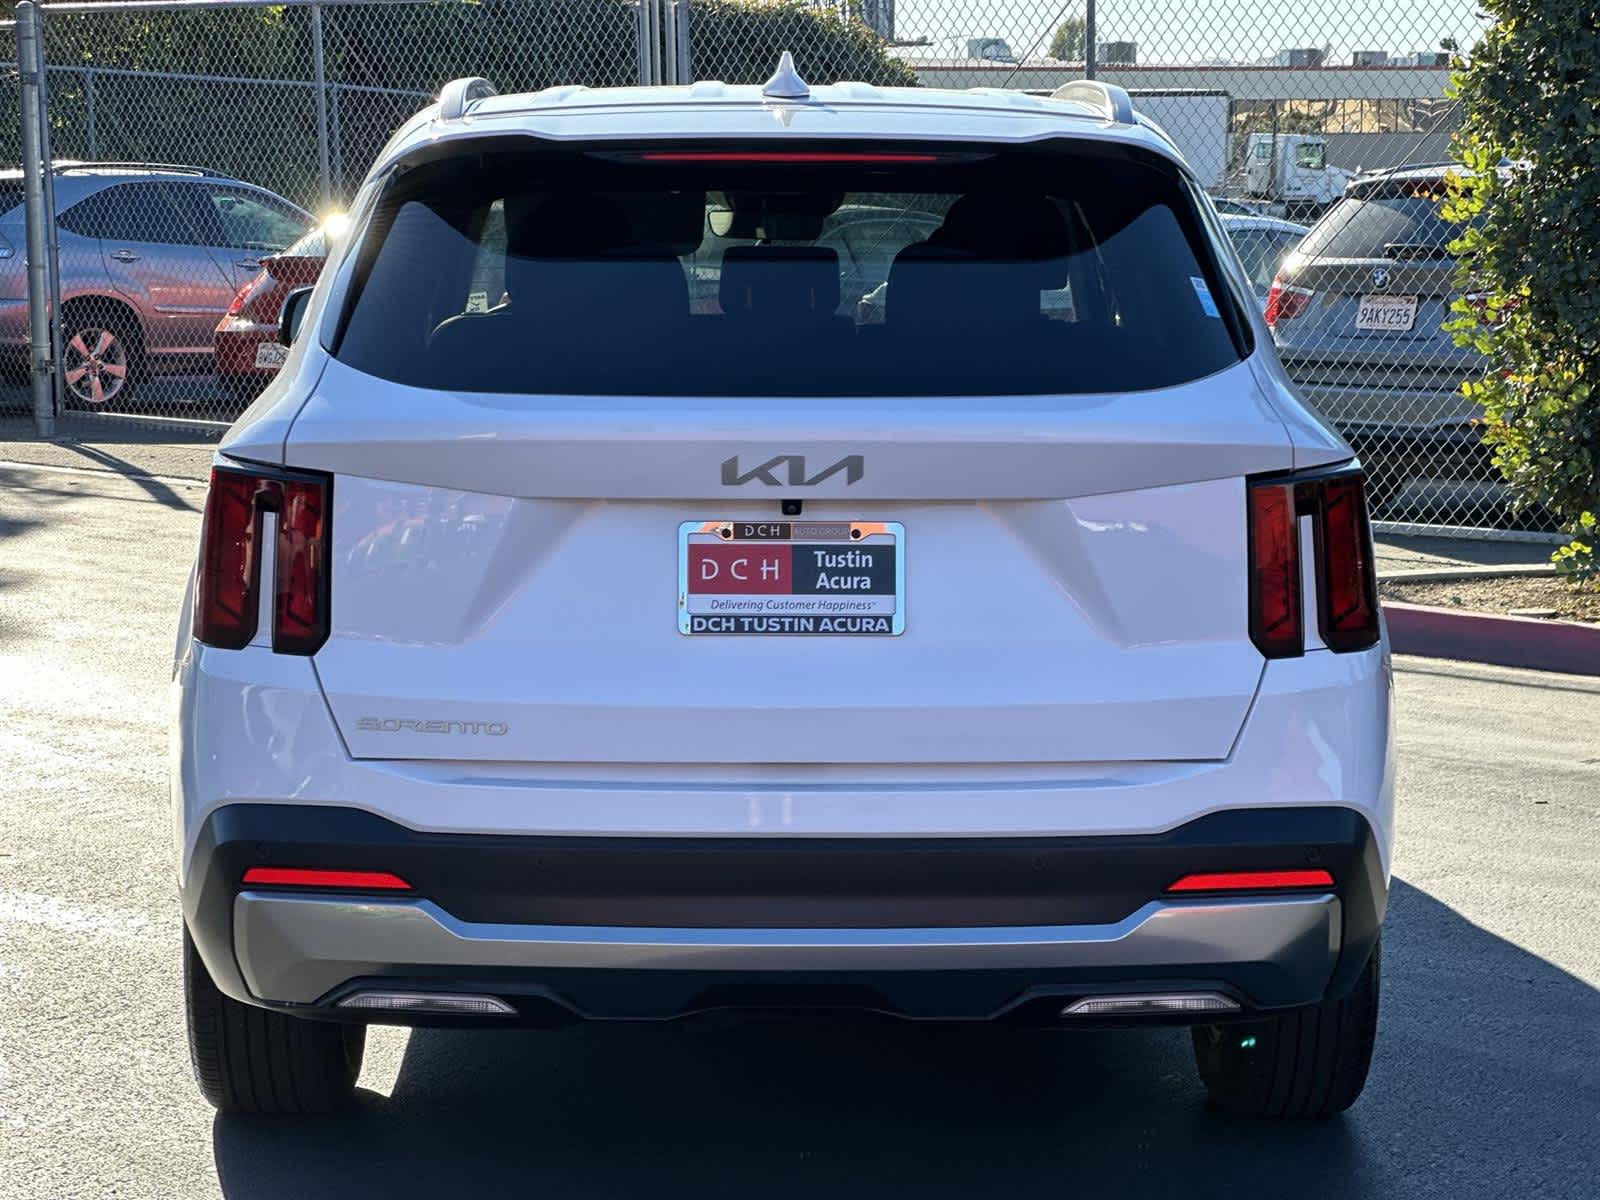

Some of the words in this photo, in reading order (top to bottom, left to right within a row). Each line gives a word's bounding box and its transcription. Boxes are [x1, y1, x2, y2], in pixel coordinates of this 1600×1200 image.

[744, 524, 781, 537] DCH
[814, 551, 873, 568] Tustin
[815, 573, 872, 589] Acura
[710, 599, 763, 611] Delivering
[766, 600, 816, 611] Customer
[693, 617, 735, 632] DCH
[740, 618, 814, 632] TUSTIN
[818, 618, 890, 632] ACURA
[355, 717, 508, 735] SORENTO
